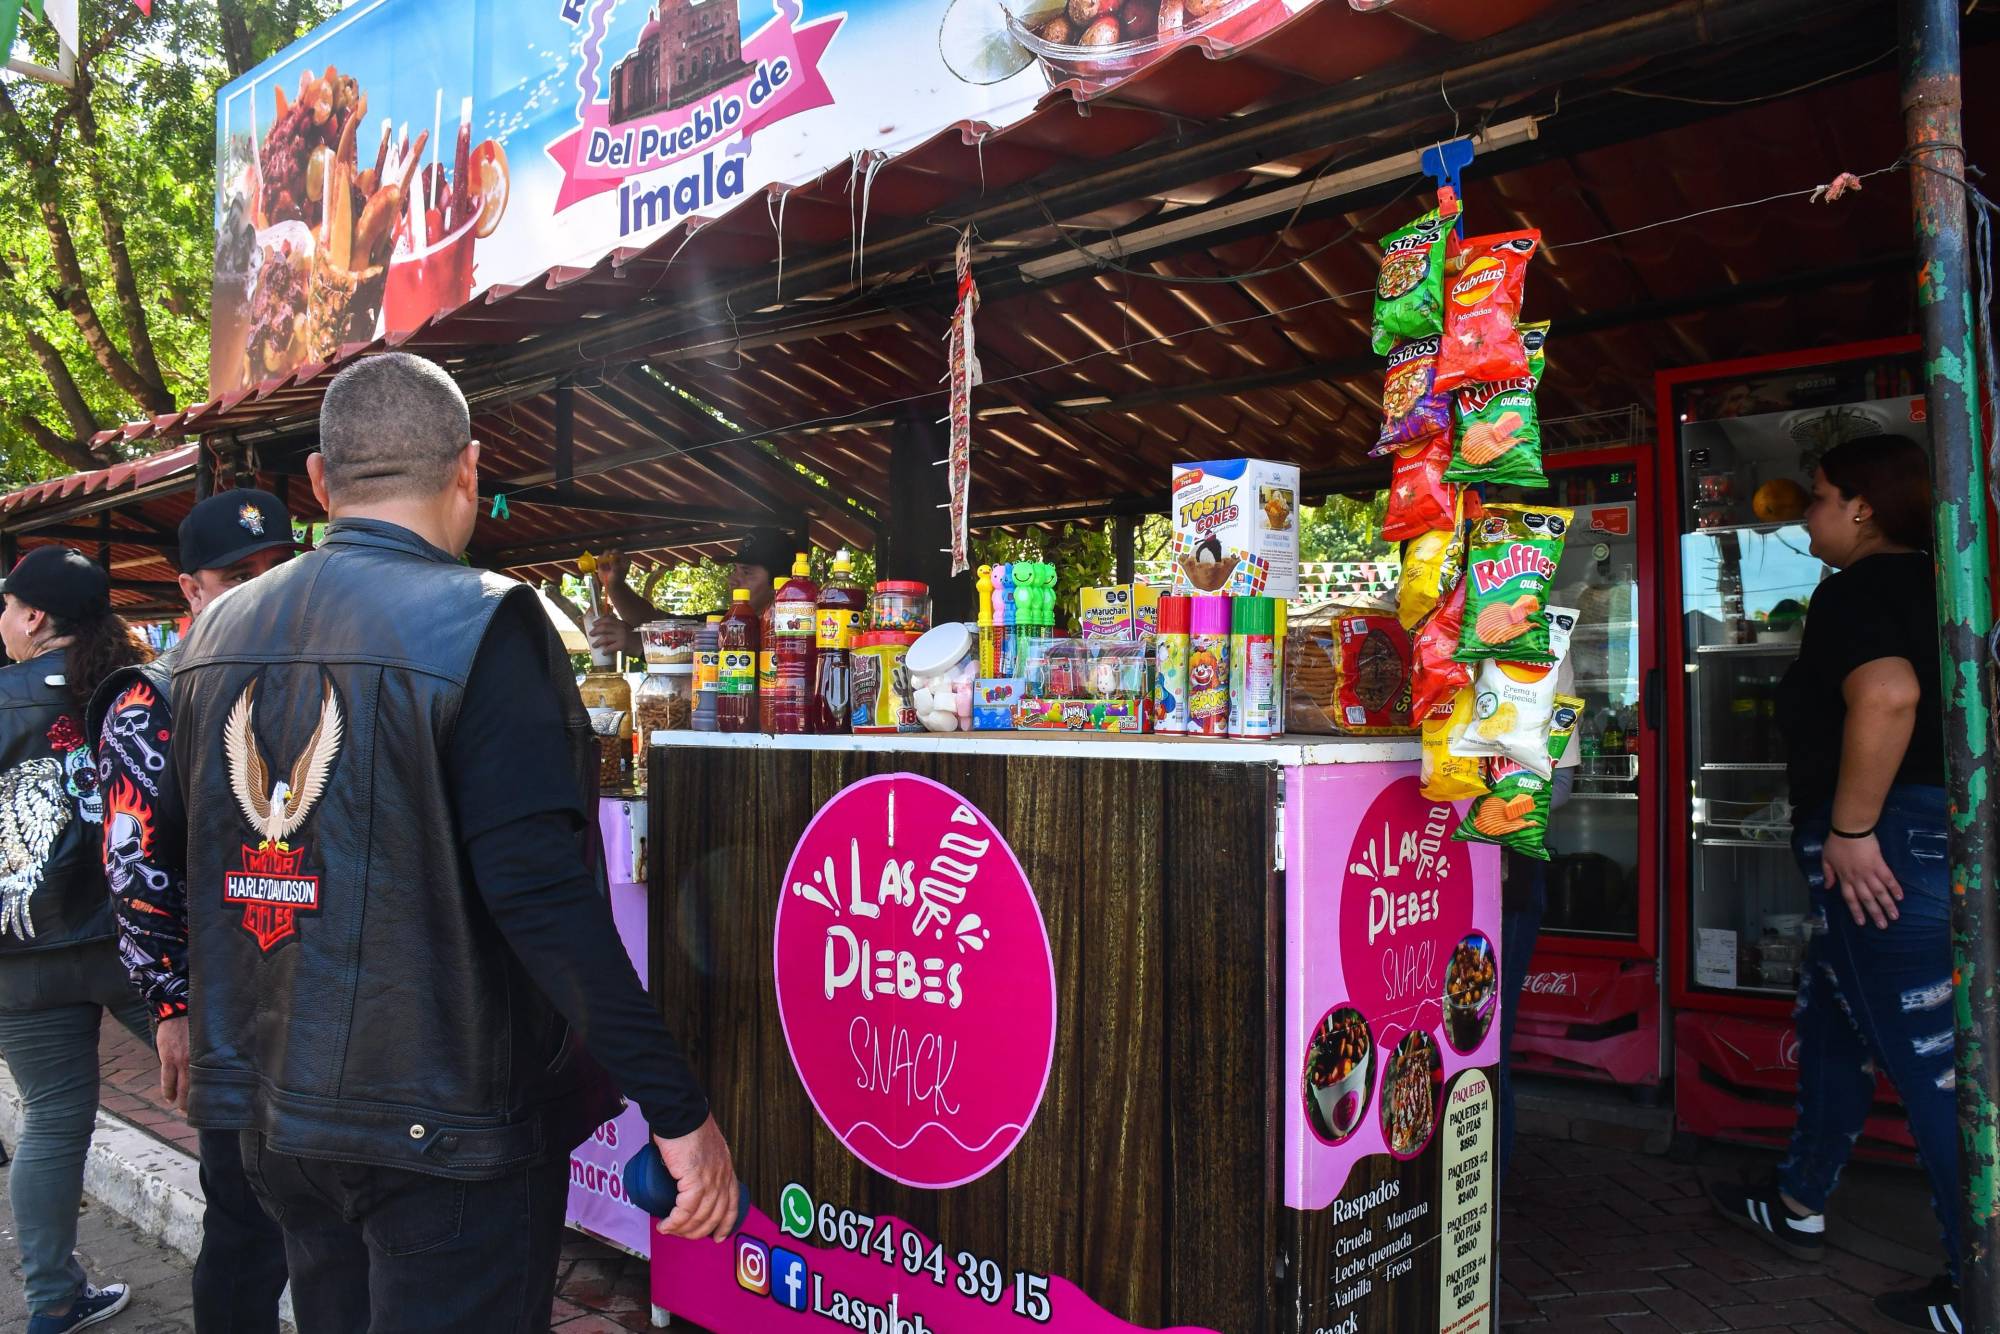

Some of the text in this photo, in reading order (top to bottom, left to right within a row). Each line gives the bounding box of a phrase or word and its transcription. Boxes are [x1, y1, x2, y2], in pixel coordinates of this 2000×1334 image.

[588, 60, 790, 164] Del Pueblo de
[619, 151, 744, 237] Imala
[1455, 268, 1505, 294] Sabritas
[1500, 397, 1531, 407] QUESO
[1397, 460, 1423, 474] Adobadas
[1180, 486, 1238, 528] TOSTY
[1196, 505, 1239, 534] CONES
[1474, 544, 1557, 593] Ruffles
[1091, 608, 1127, 616] Maruchan
[1503, 691, 1537, 705] Especias
[1504, 685, 1531, 696] Crema
[899, 708, 917, 725] 18
[1383, 821, 1418, 877] LAS
[849, 837, 915, 919] LAS
[1368, 886, 1440, 946] PLEBES
[824, 925, 963, 1009] PLEBES
[1381, 938, 1438, 1001] SNACK
[848, 1015, 960, 1115] SNACK
[1452, 1080, 1486, 1105] PAQUETES
[1449, 1102, 1481, 1126] PAQUETES
[1465, 1117, 1481, 1134] PZAS
[1447, 1155, 1479, 1180] PAQUETES
[1465, 1169, 1481, 1187] PZAS
[1332, 1179, 1400, 1226] Raspados
[1446, 1207, 1479, 1234] PAQUETES
[1465, 1220, 1481, 1239] PZAS
[817, 1203, 1052, 1322] 6674 94 39 15
[1367, 1232, 1412, 1267] quemada
[1445, 1258, 1477, 1287] PAQUETES
[1464, 1271, 1480, 1291] PZAS
